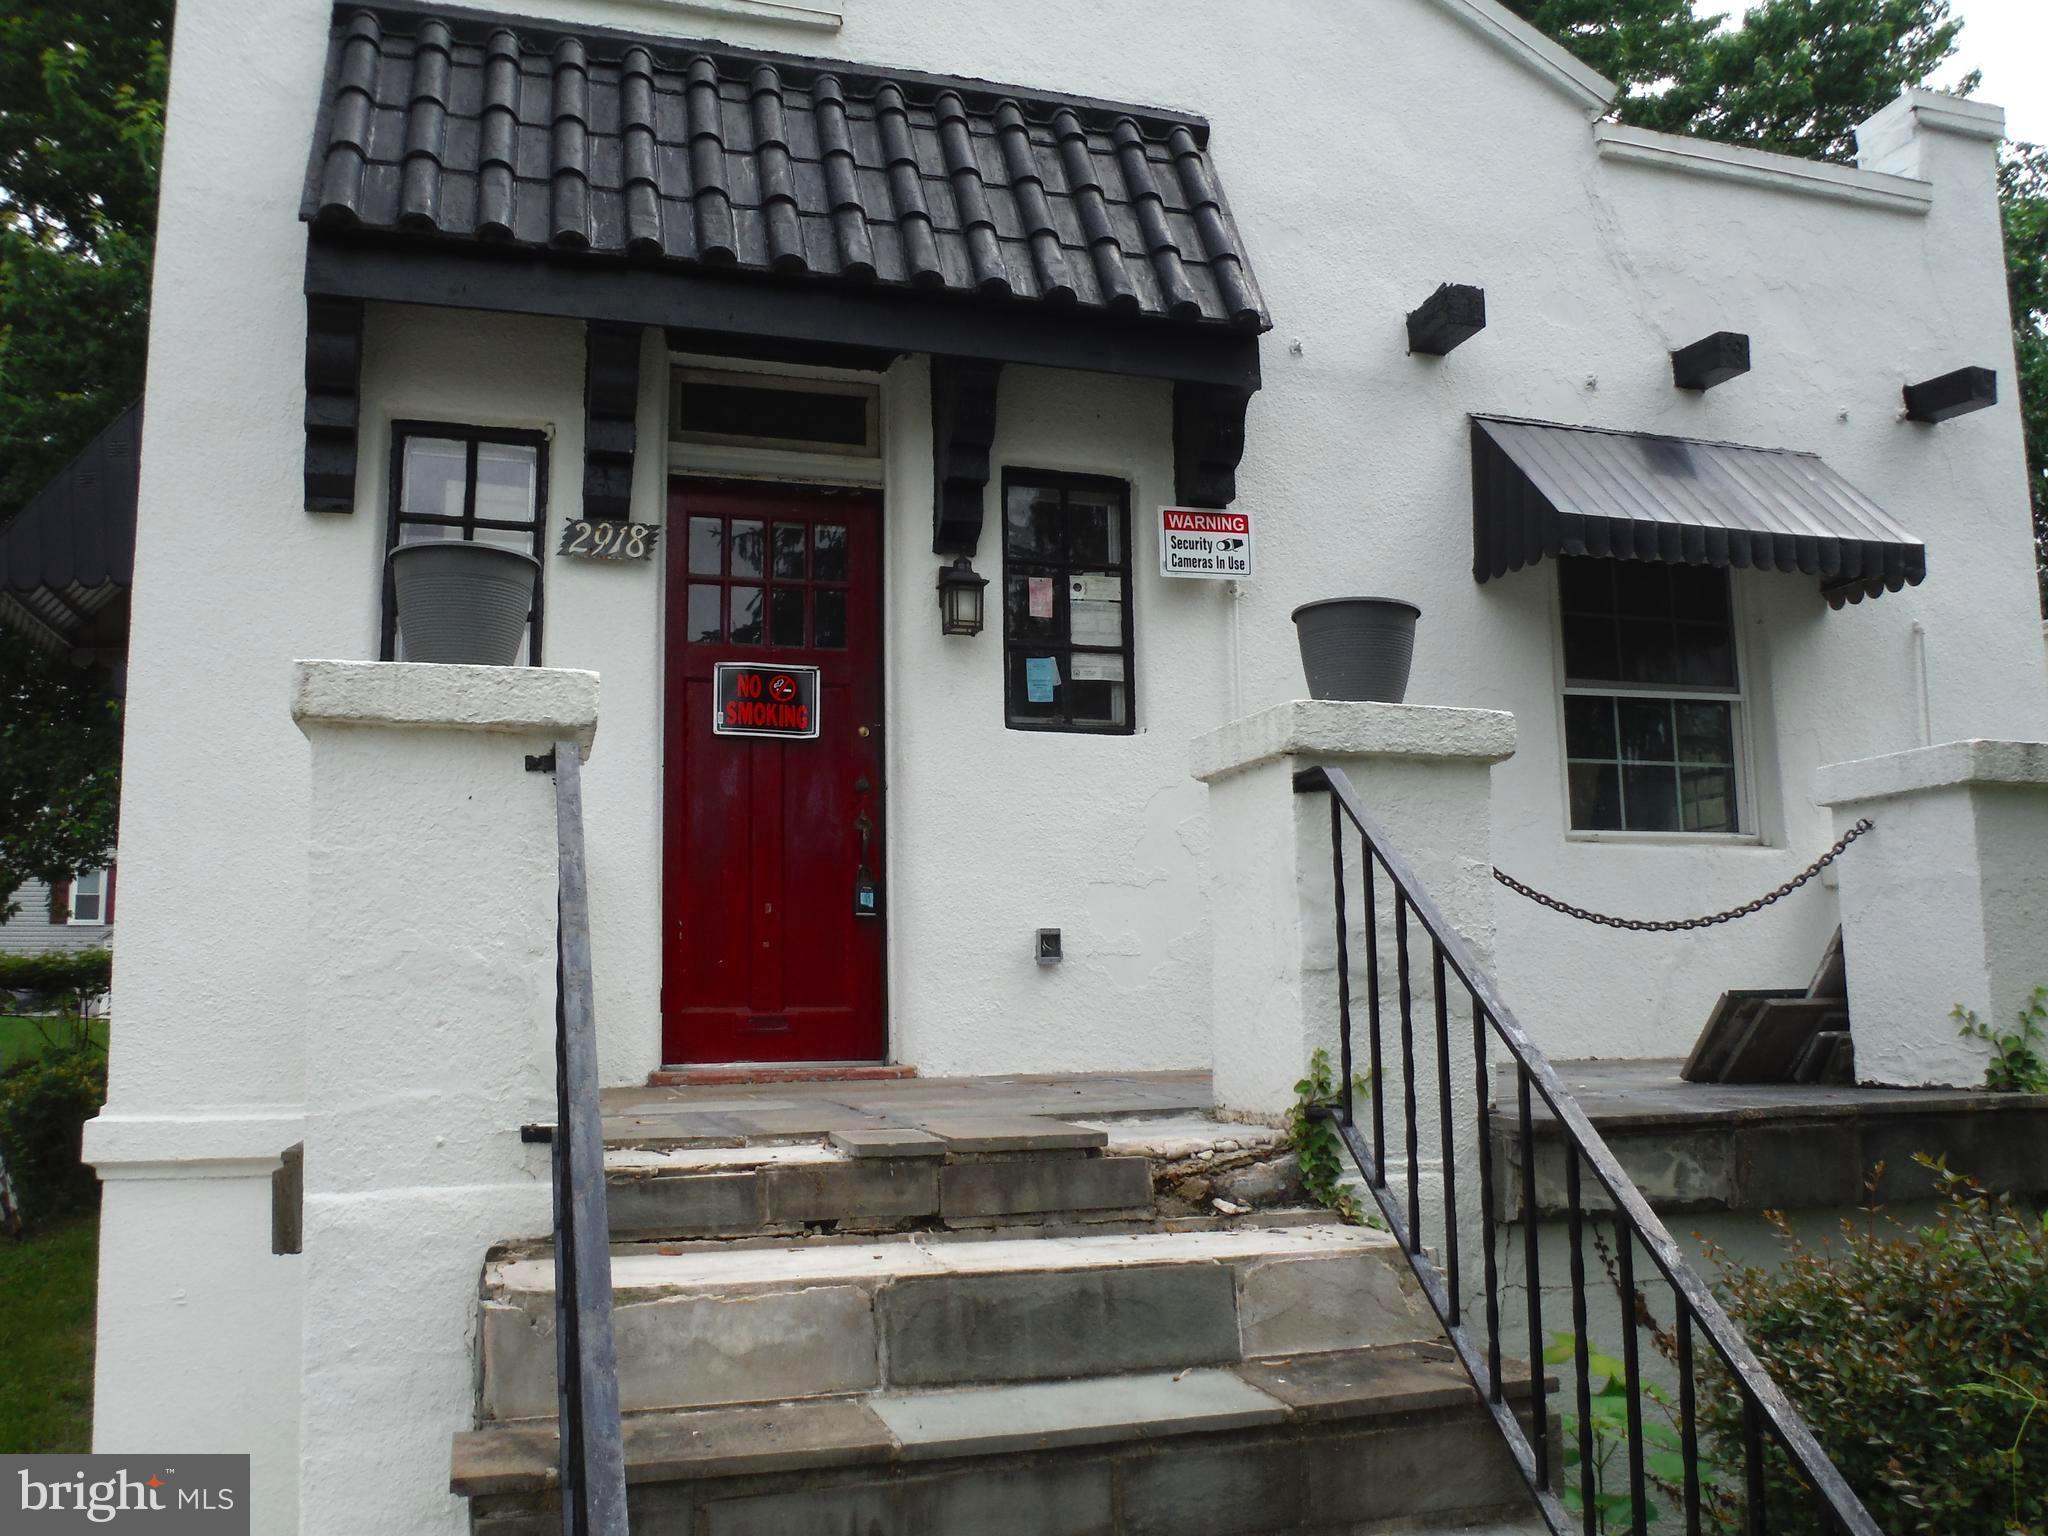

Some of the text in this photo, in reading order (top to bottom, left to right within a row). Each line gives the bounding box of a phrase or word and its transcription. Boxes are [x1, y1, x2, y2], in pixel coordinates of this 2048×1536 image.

[1168, 514, 1244, 531] WARNING
[569, 522, 648, 558] 2918
[1170, 535, 1213, 553] Security
[1171, 553, 1245, 570] Cameras In Use
[737, 673, 762, 698] NO
[726, 701, 808, 729] SMOKING
